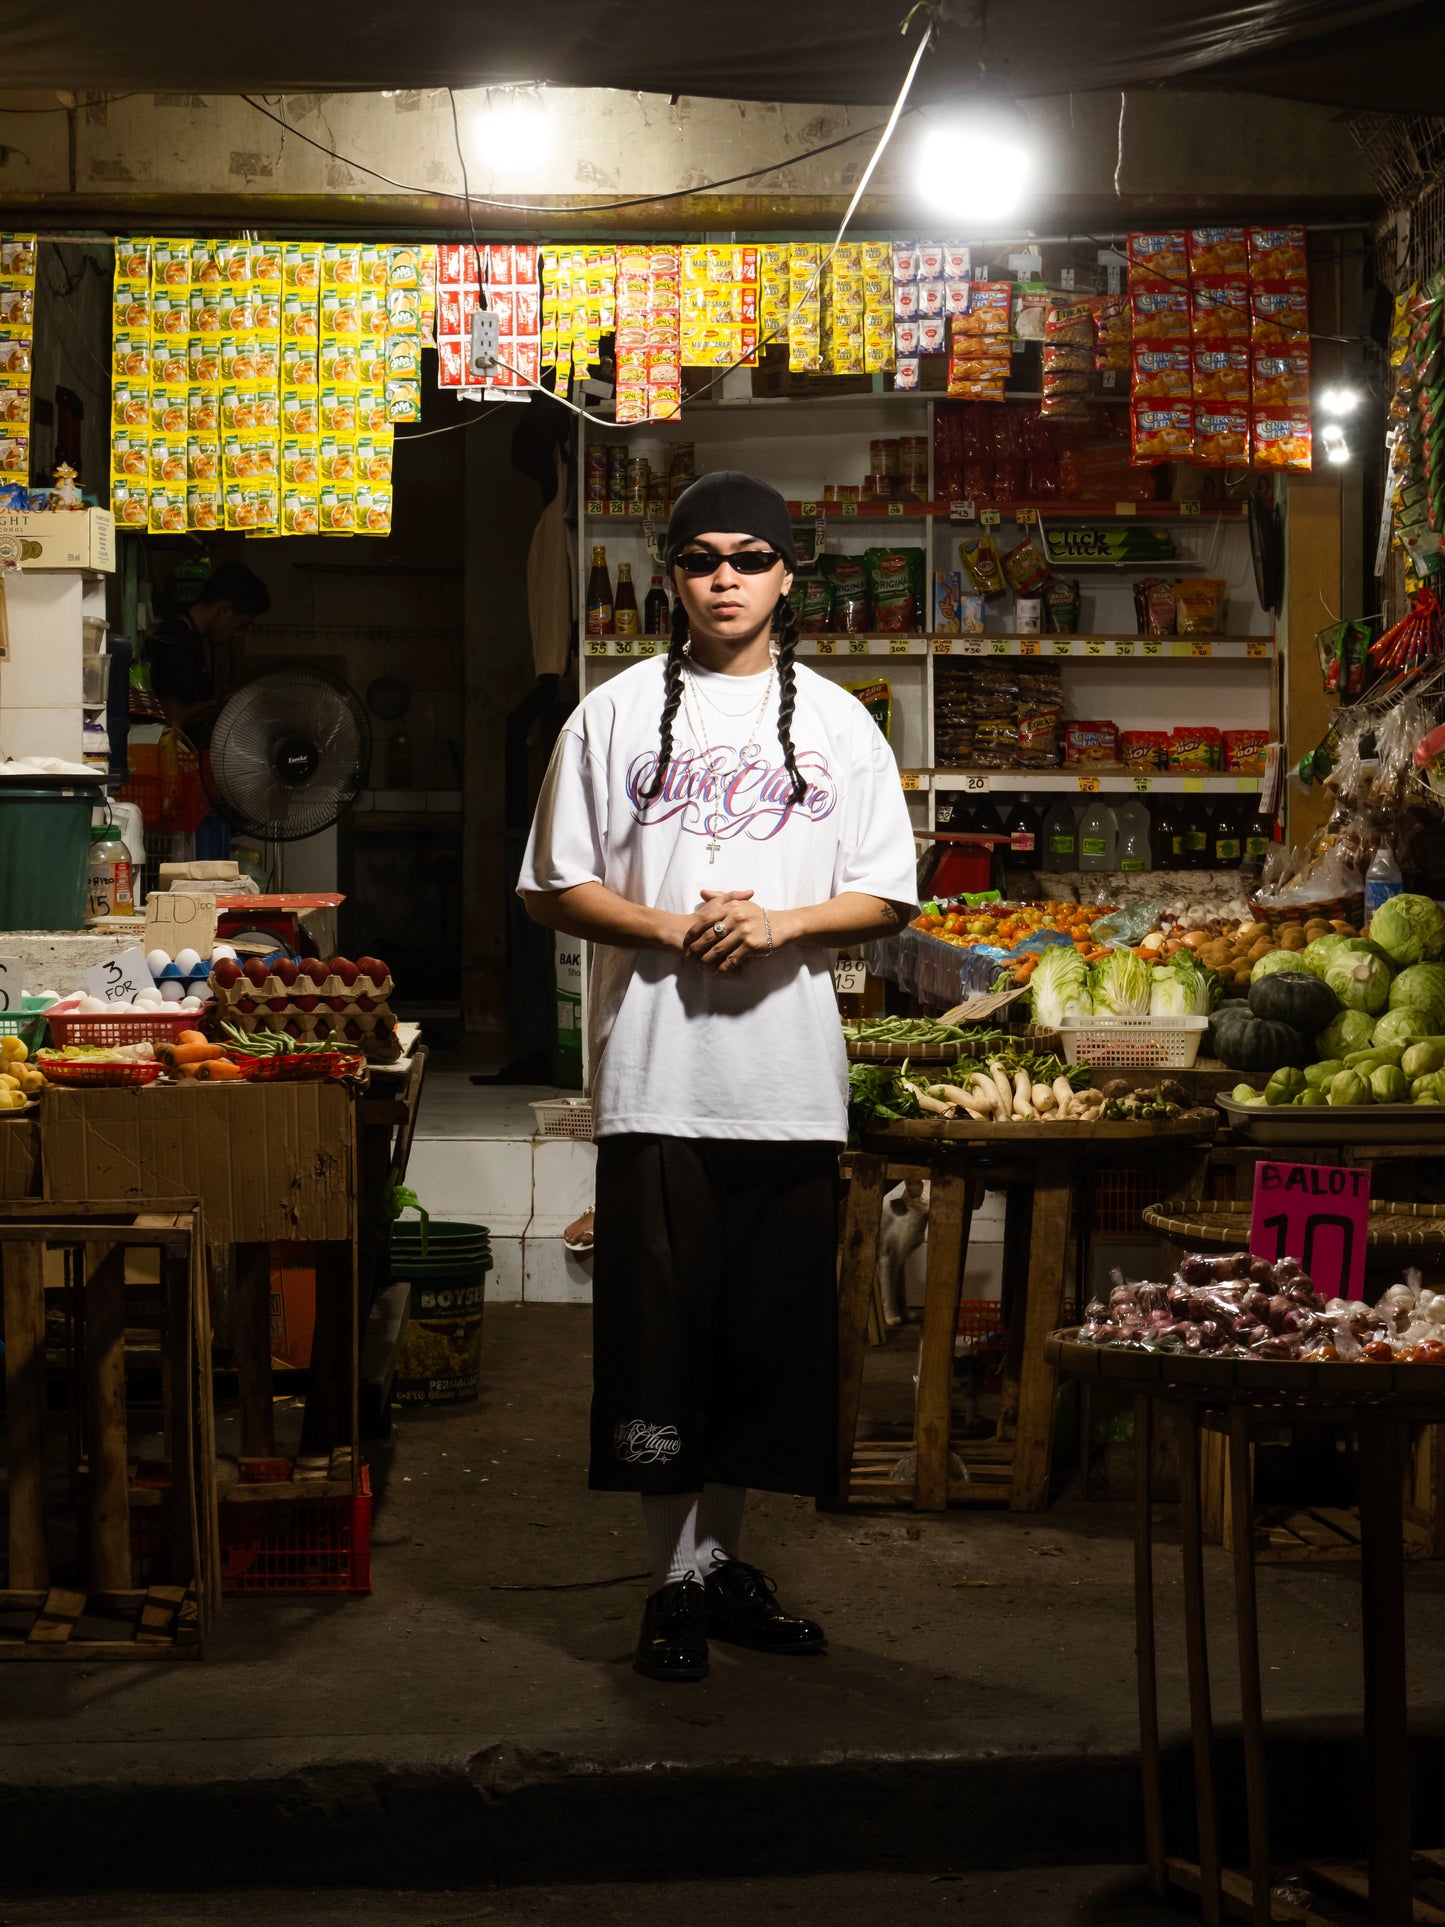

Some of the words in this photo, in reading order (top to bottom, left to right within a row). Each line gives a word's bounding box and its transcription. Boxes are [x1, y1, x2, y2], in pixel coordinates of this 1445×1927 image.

[1272, 429, 1290, 439] FRY
[590, 504, 602, 513] 28
[612, 504, 622, 513] 28
[816, 534, 825, 546] 22
[591, 644, 607, 654] 55
[616, 643, 632, 654] 30
[640, 646, 654, 654] 50
[850, 645, 864, 653] 32
[934, 645, 950, 654] 125
[968, 779, 985, 789] 20
[90, 896, 110, 916] 15
[103, 960, 123, 984] 3
[835, 974, 856, 989] 15
[105, 980, 137, 1001] FOR
[1261, 1165, 1365, 1197] BALOT
[1264, 1213, 1354, 1300] 10
